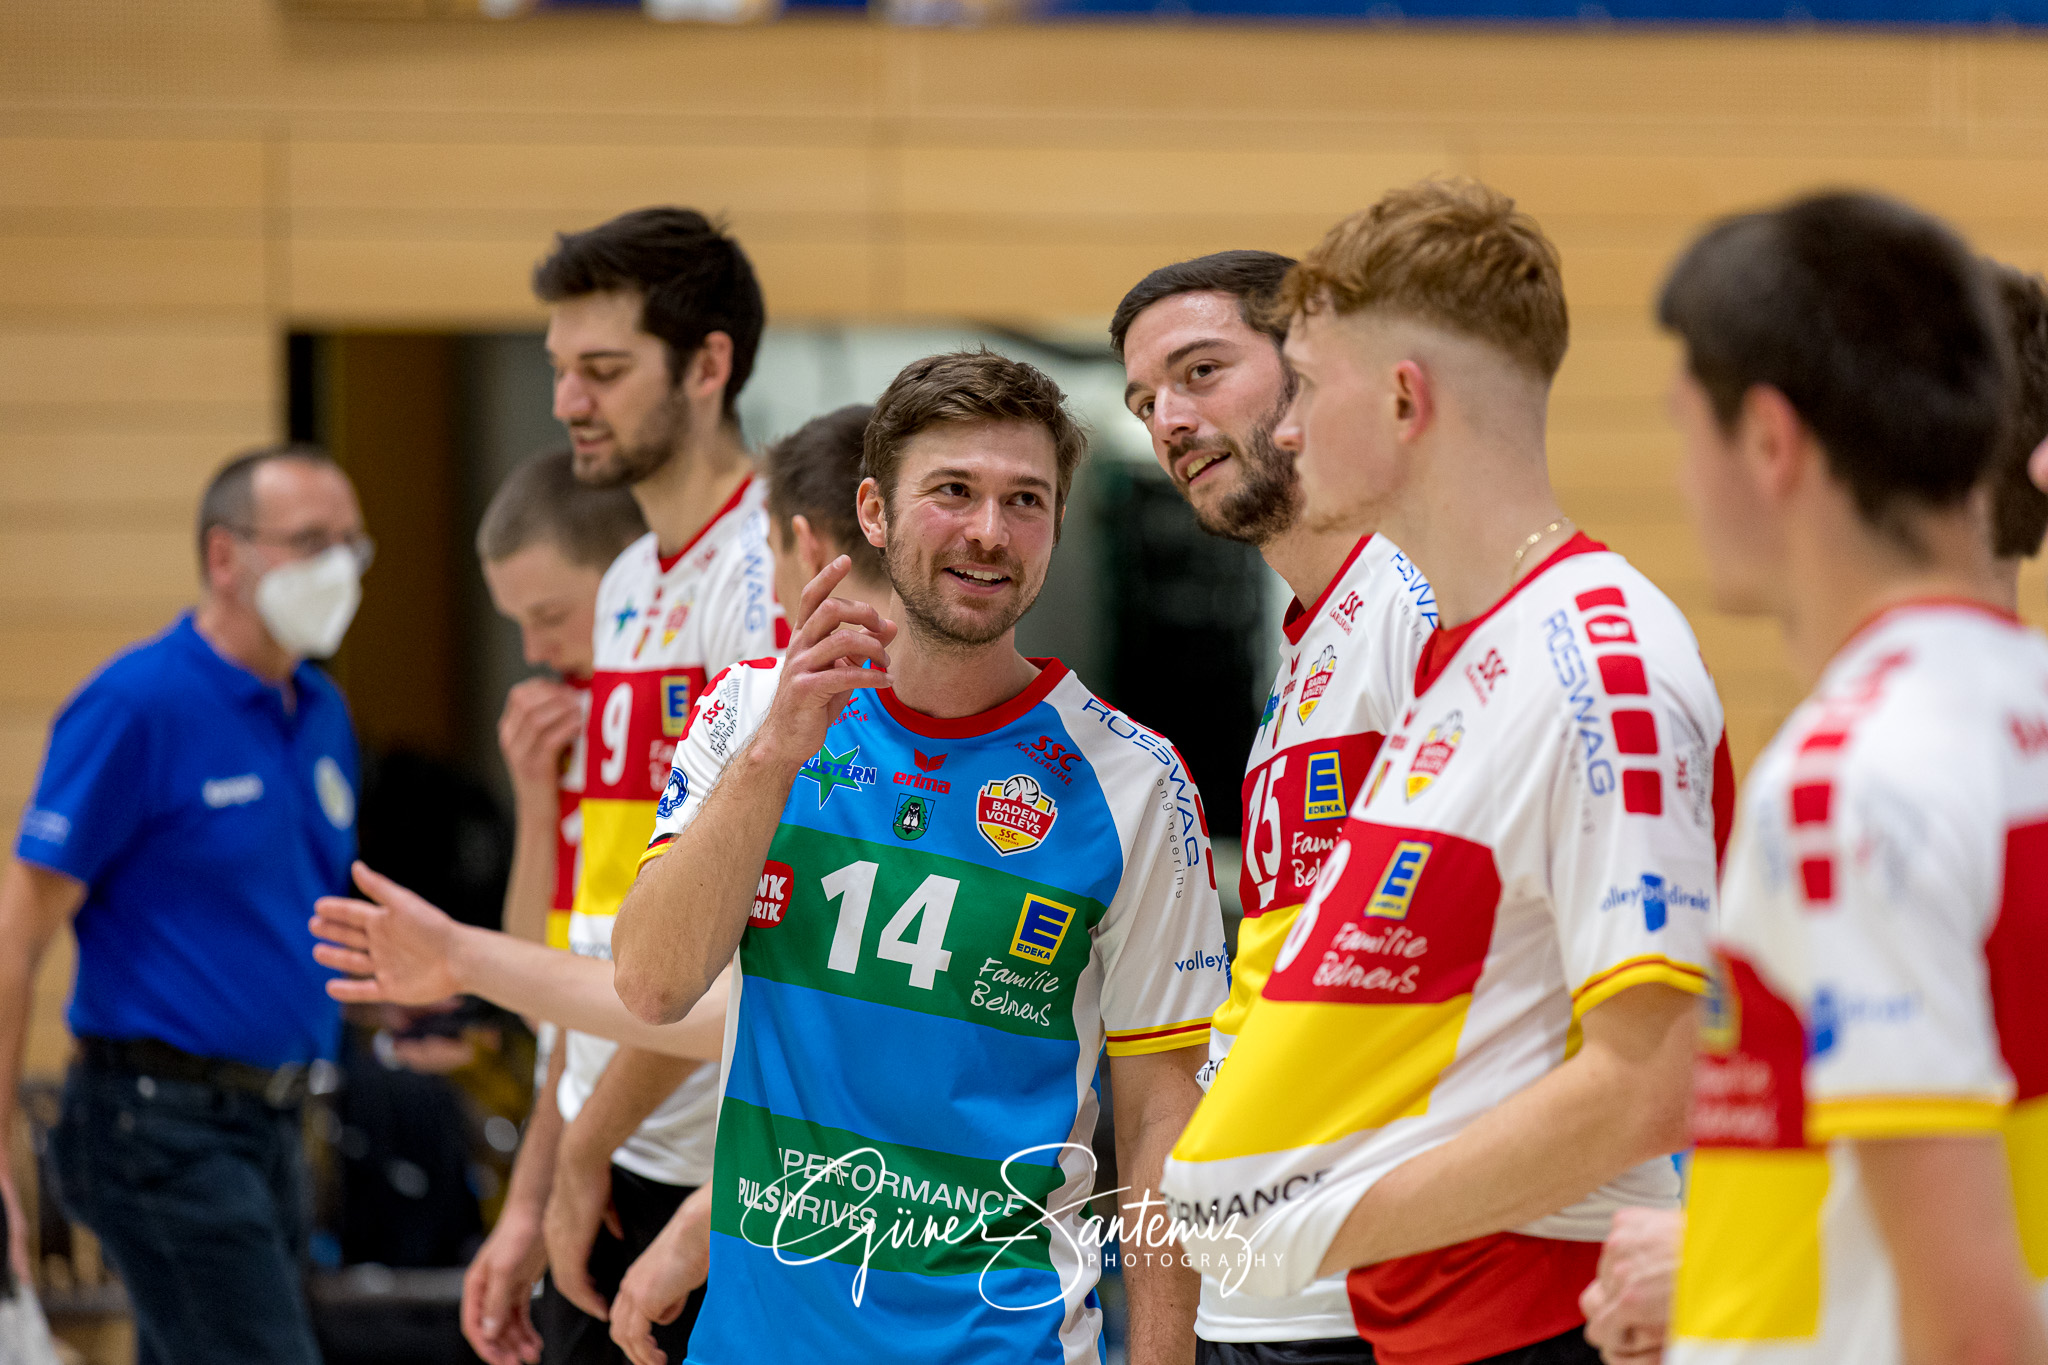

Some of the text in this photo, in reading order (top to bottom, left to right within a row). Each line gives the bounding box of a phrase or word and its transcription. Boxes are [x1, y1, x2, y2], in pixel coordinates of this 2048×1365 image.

[1339, 590, 1364, 622] SSC
[601, 682, 632, 787] 9
[1014, 741, 1073, 786] KARLSRUHE
[1031, 735, 1082, 772] SSC
[893, 771, 951, 794] erima
[1082, 698, 1200, 867] ROSSWAG
[985, 809, 1041, 834] VOLLEYS
[992, 800, 1041, 823] BADEN
[1308, 804, 1342, 815] EDEKA
[999, 828, 1019, 841] SSC
[1156, 778, 1185, 899] engineering
[1246, 755, 1288, 909] 15
[820, 860, 960, 991] 14
[1330, 921, 1429, 959] Familie
[1016, 942, 1051, 960] EDEKA
[979, 957, 1059, 993] Familie
[1312, 950, 1421, 994] Behrens
[970, 980, 1051, 1027] Behrens
